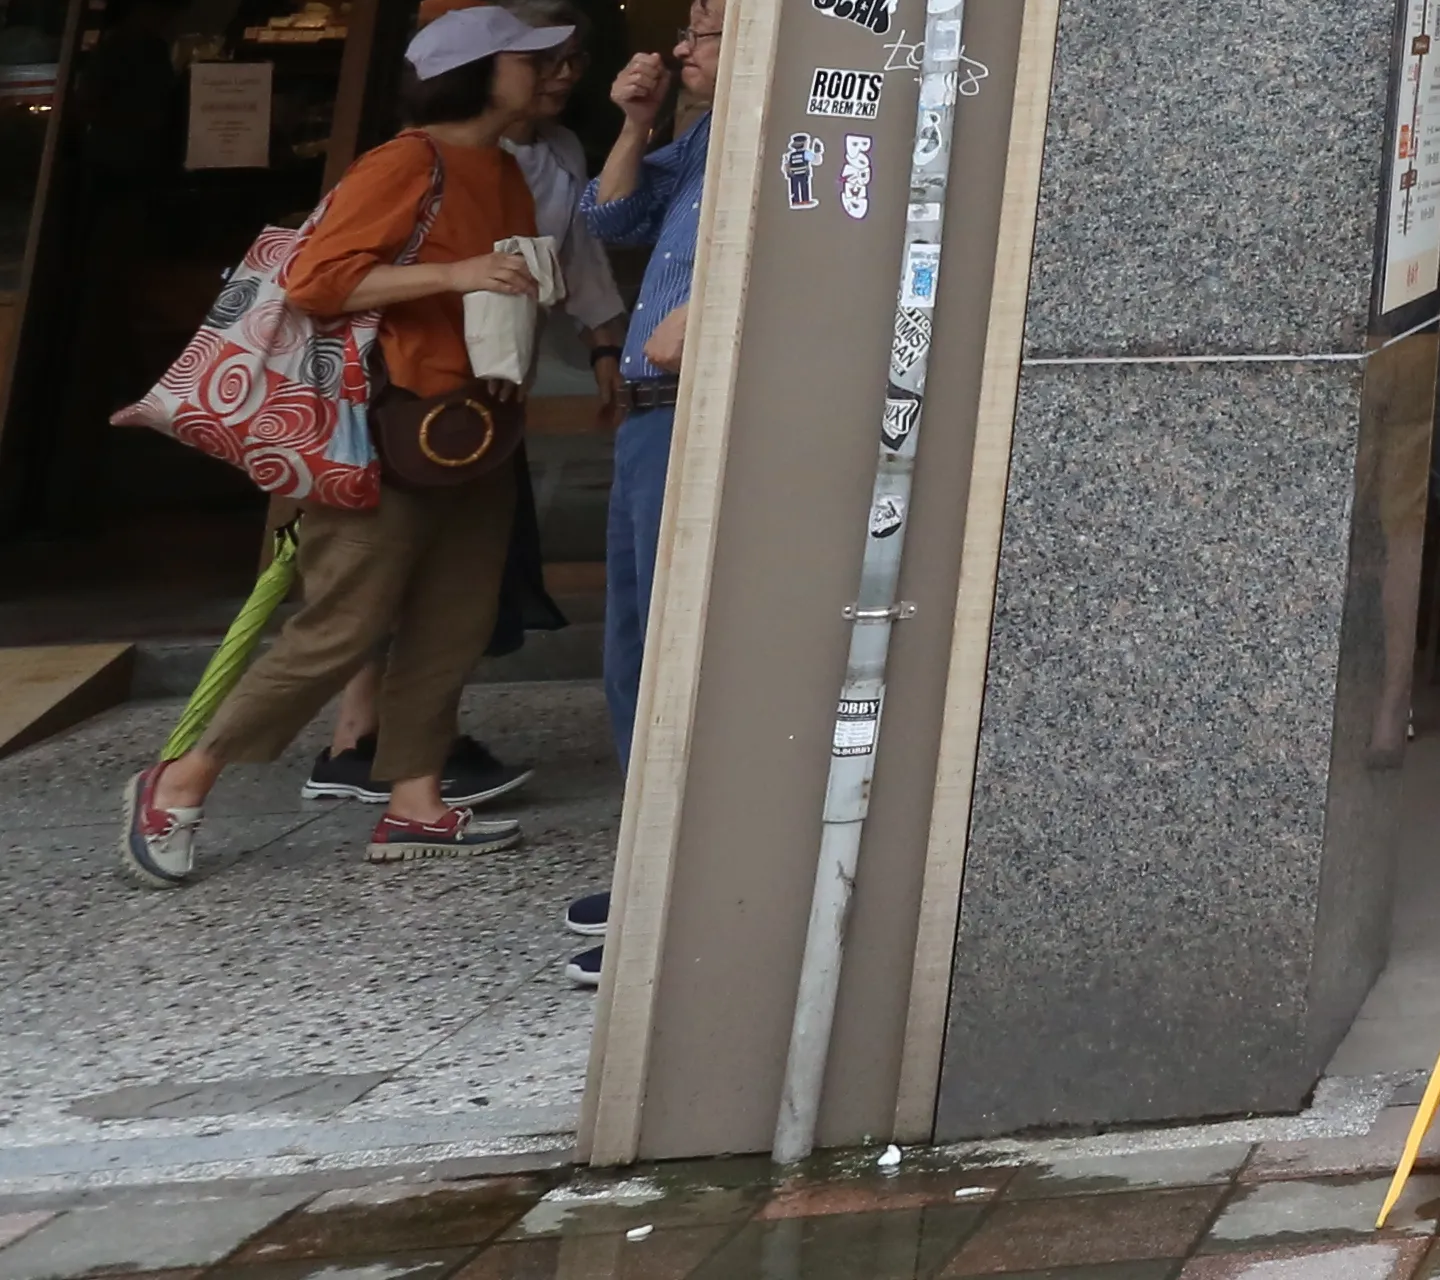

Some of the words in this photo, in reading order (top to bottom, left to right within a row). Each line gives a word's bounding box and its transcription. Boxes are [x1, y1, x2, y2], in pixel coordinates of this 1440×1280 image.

[813, 71, 882, 101] ROOTS
[809, 98, 828, 113] 842
[831, 100, 853, 115] REM
[855, 101, 876, 117] 2KR
[836, 702, 879, 714] OBBY
